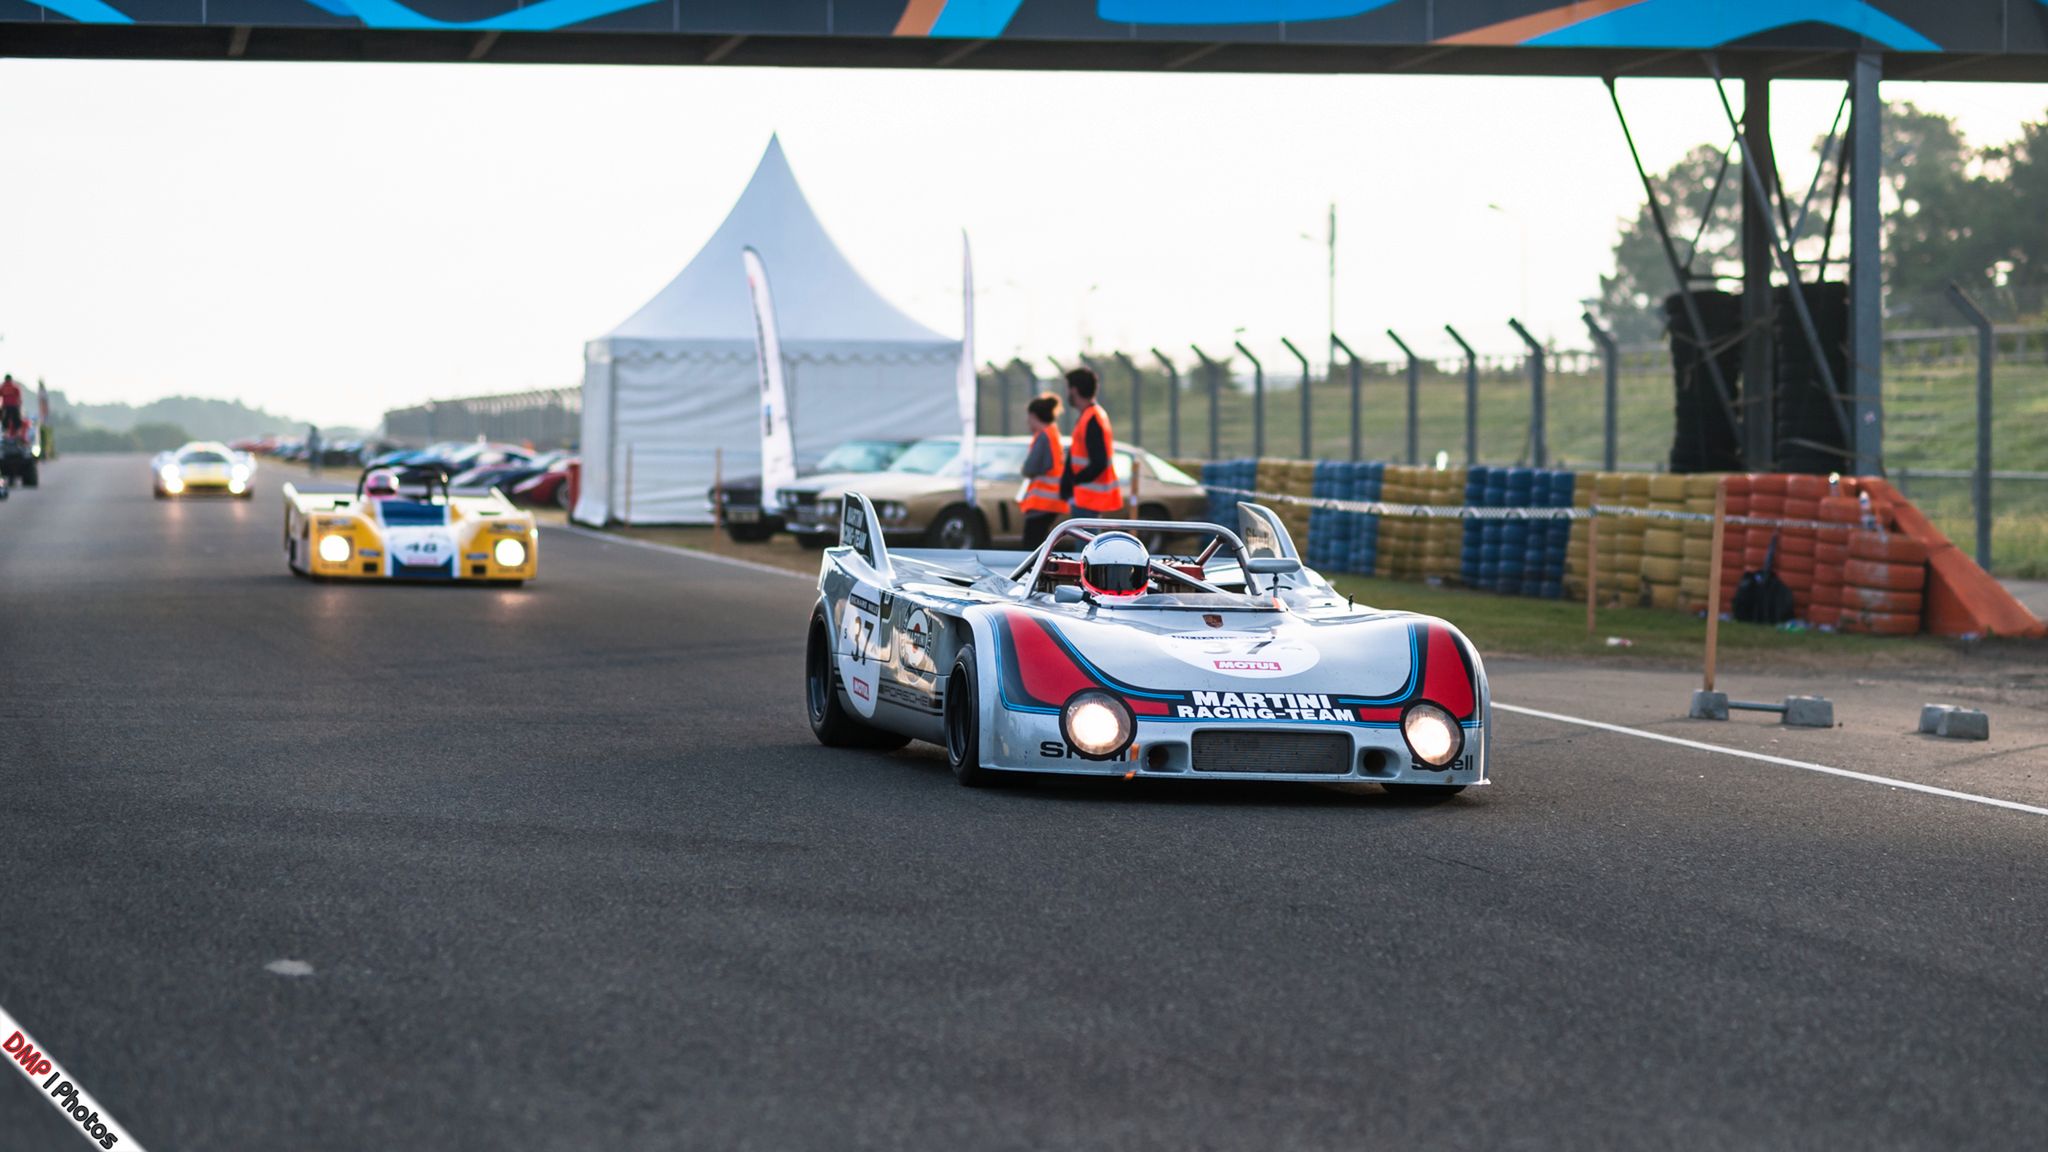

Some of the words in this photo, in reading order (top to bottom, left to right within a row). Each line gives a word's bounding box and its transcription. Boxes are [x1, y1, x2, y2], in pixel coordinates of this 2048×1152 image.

[851, 616, 875, 666] 37
[1218, 660, 1279, 670] MOTUL
[1191, 691, 1332, 709] MARTINI
[1177, 705, 1356, 722] RACING-TEAM
